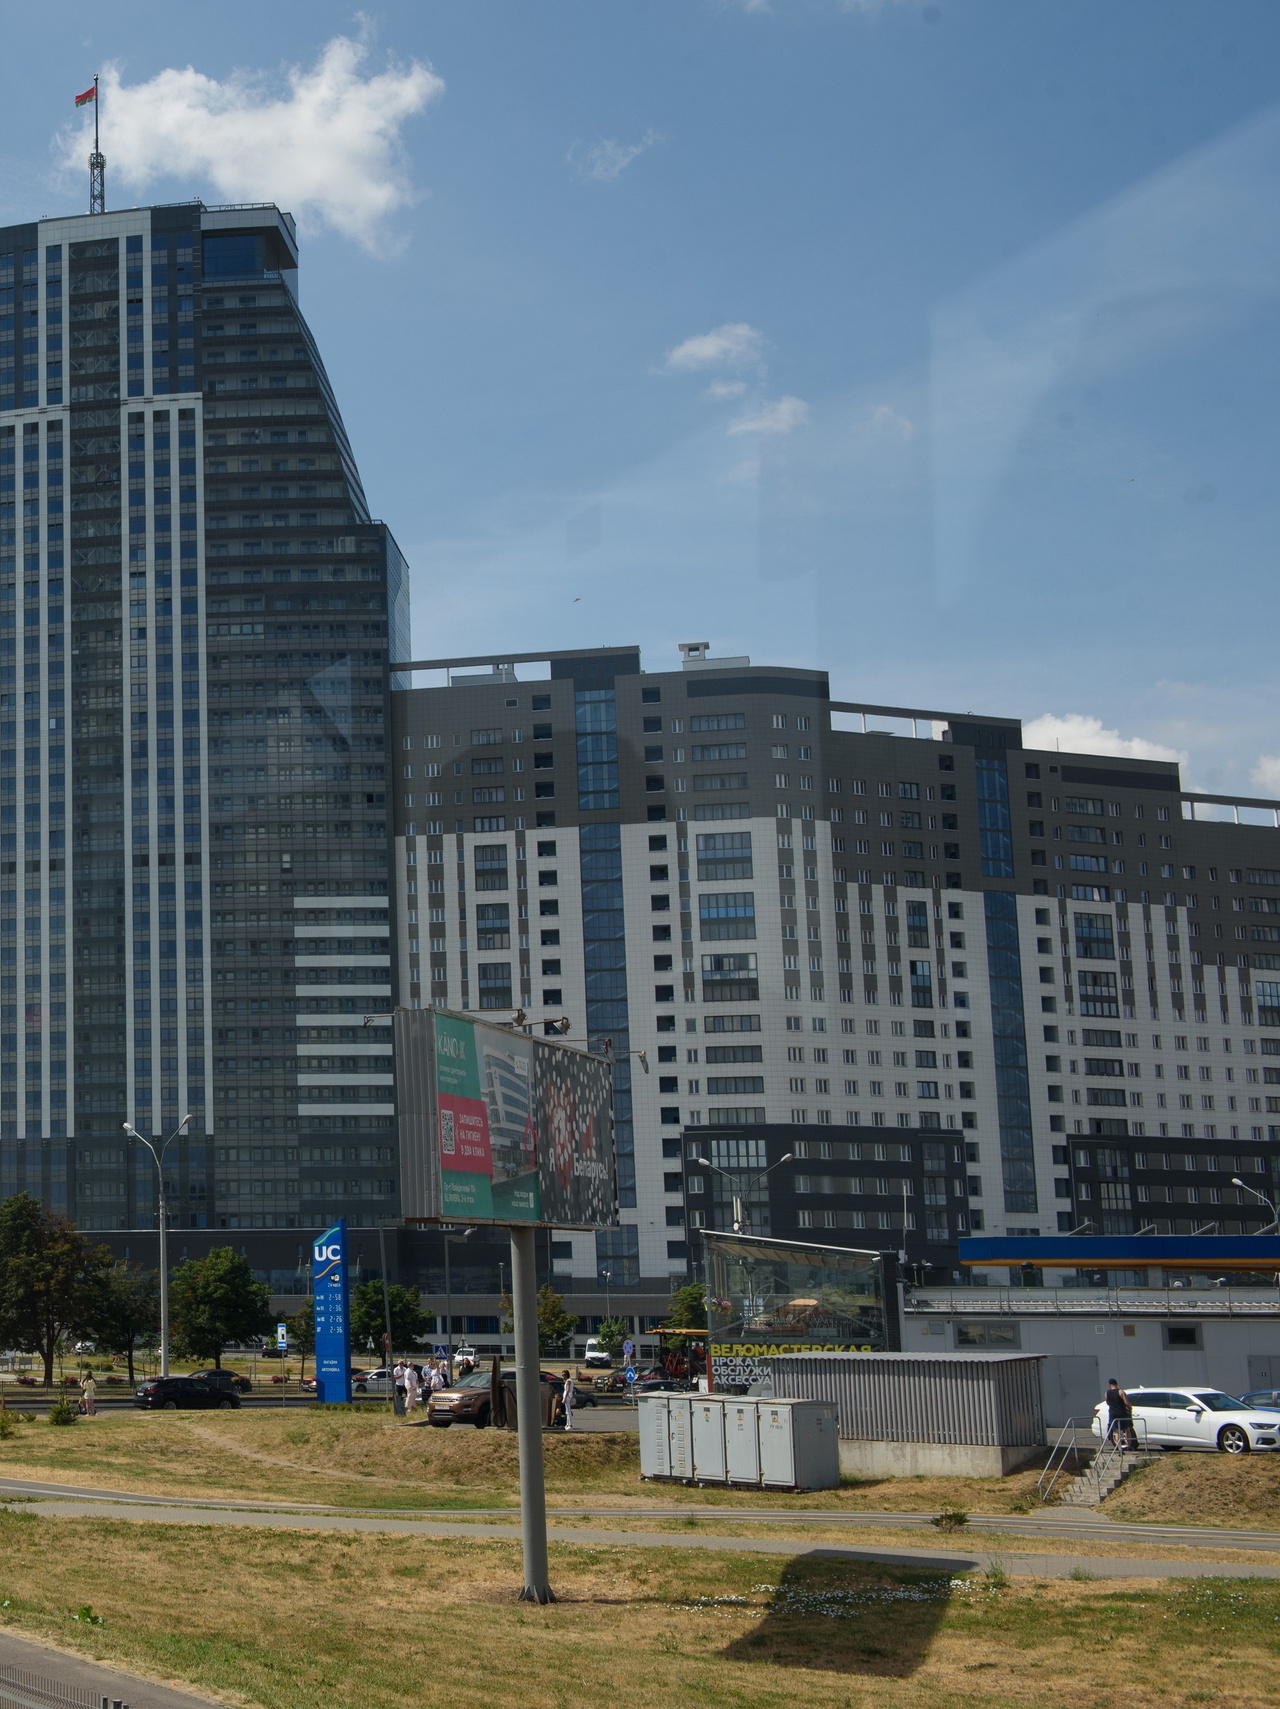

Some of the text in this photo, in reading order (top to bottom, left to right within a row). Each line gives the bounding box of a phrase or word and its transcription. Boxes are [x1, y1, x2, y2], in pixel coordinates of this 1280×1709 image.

[549, 1147, 609, 1185] Я Беларусь!
[314, 1245, 341, 1261] UC
[711, 1357, 760, 1366] ПРОКАТ
